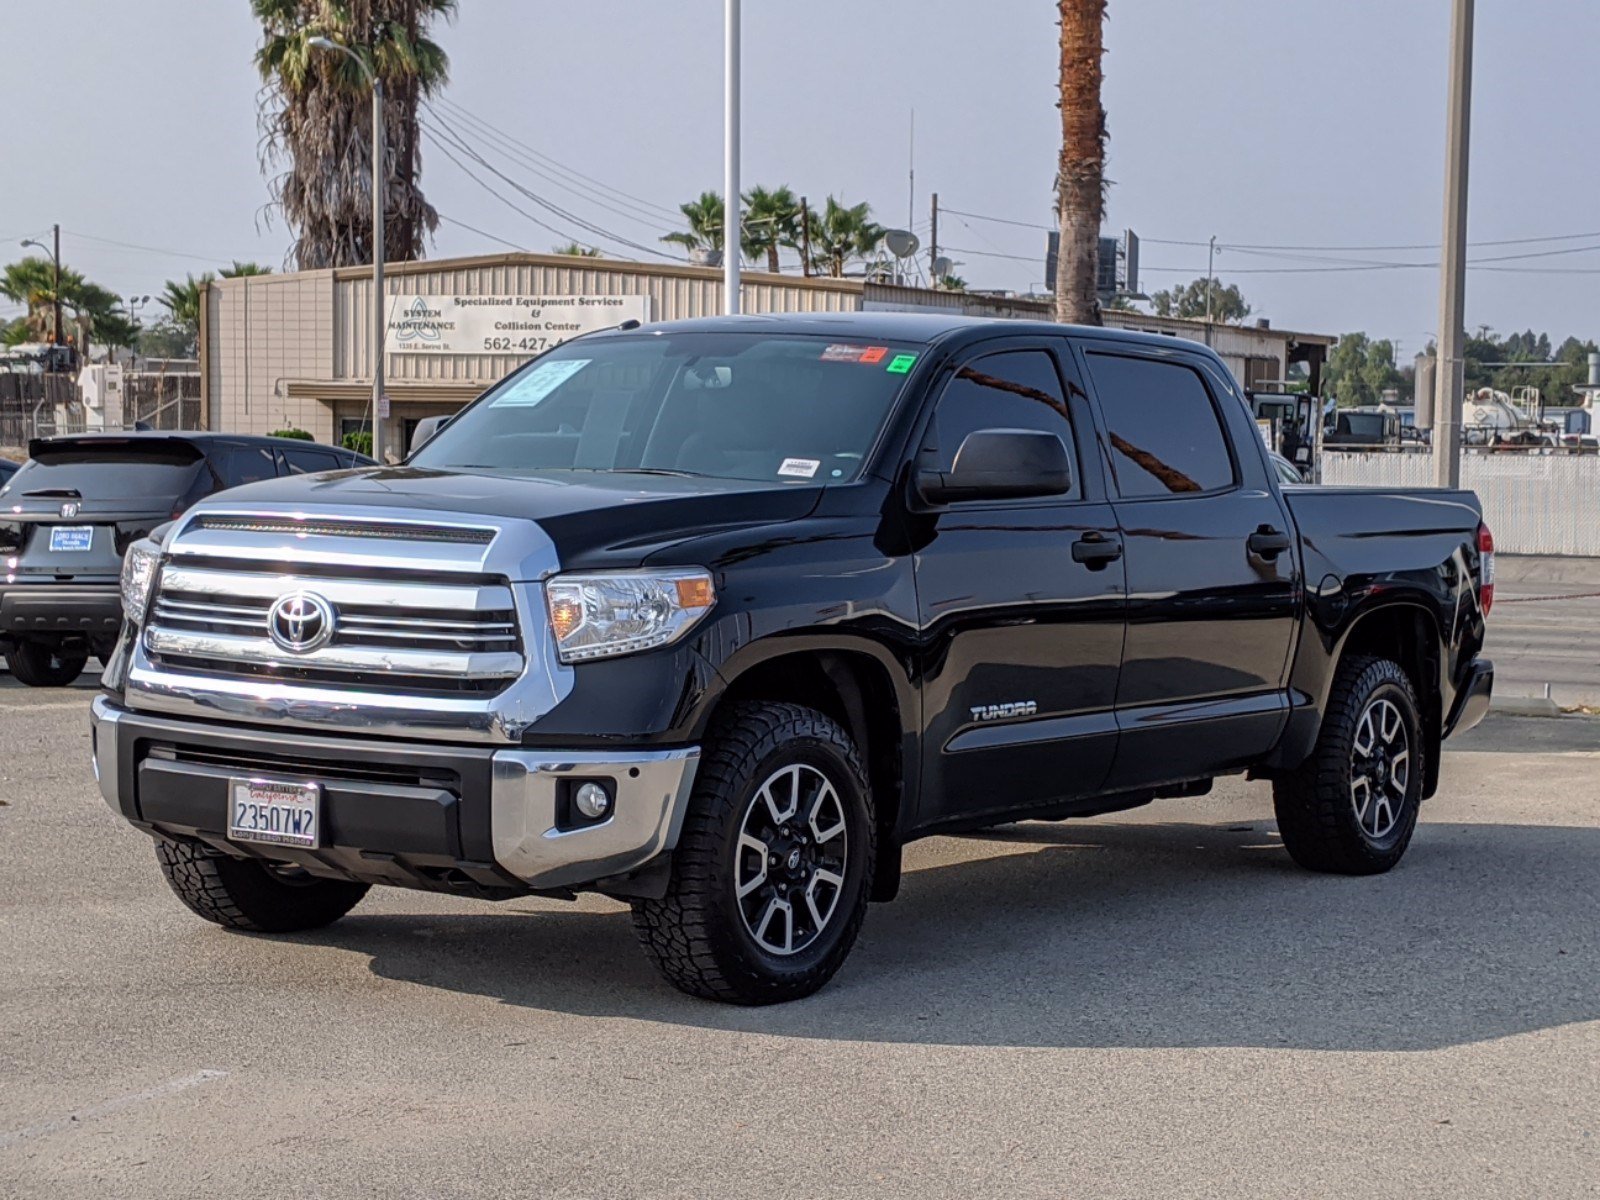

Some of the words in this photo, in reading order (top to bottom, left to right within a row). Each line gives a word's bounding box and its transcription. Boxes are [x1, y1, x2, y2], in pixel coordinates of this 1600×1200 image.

[453, 297, 513, 307] Specialized
[516, 297, 575, 307] Equipment
[578, 297, 624, 306] Services
[403, 309, 442, 318] SYSTEM
[531, 309, 541, 318] &
[388, 321, 456, 330] MAINTENANCE
[494, 321, 541, 330] Collision
[545, 321, 581, 330] Center
[970, 700, 1037, 721] TUNDRA
[237, 802, 314, 835] 23507W2
